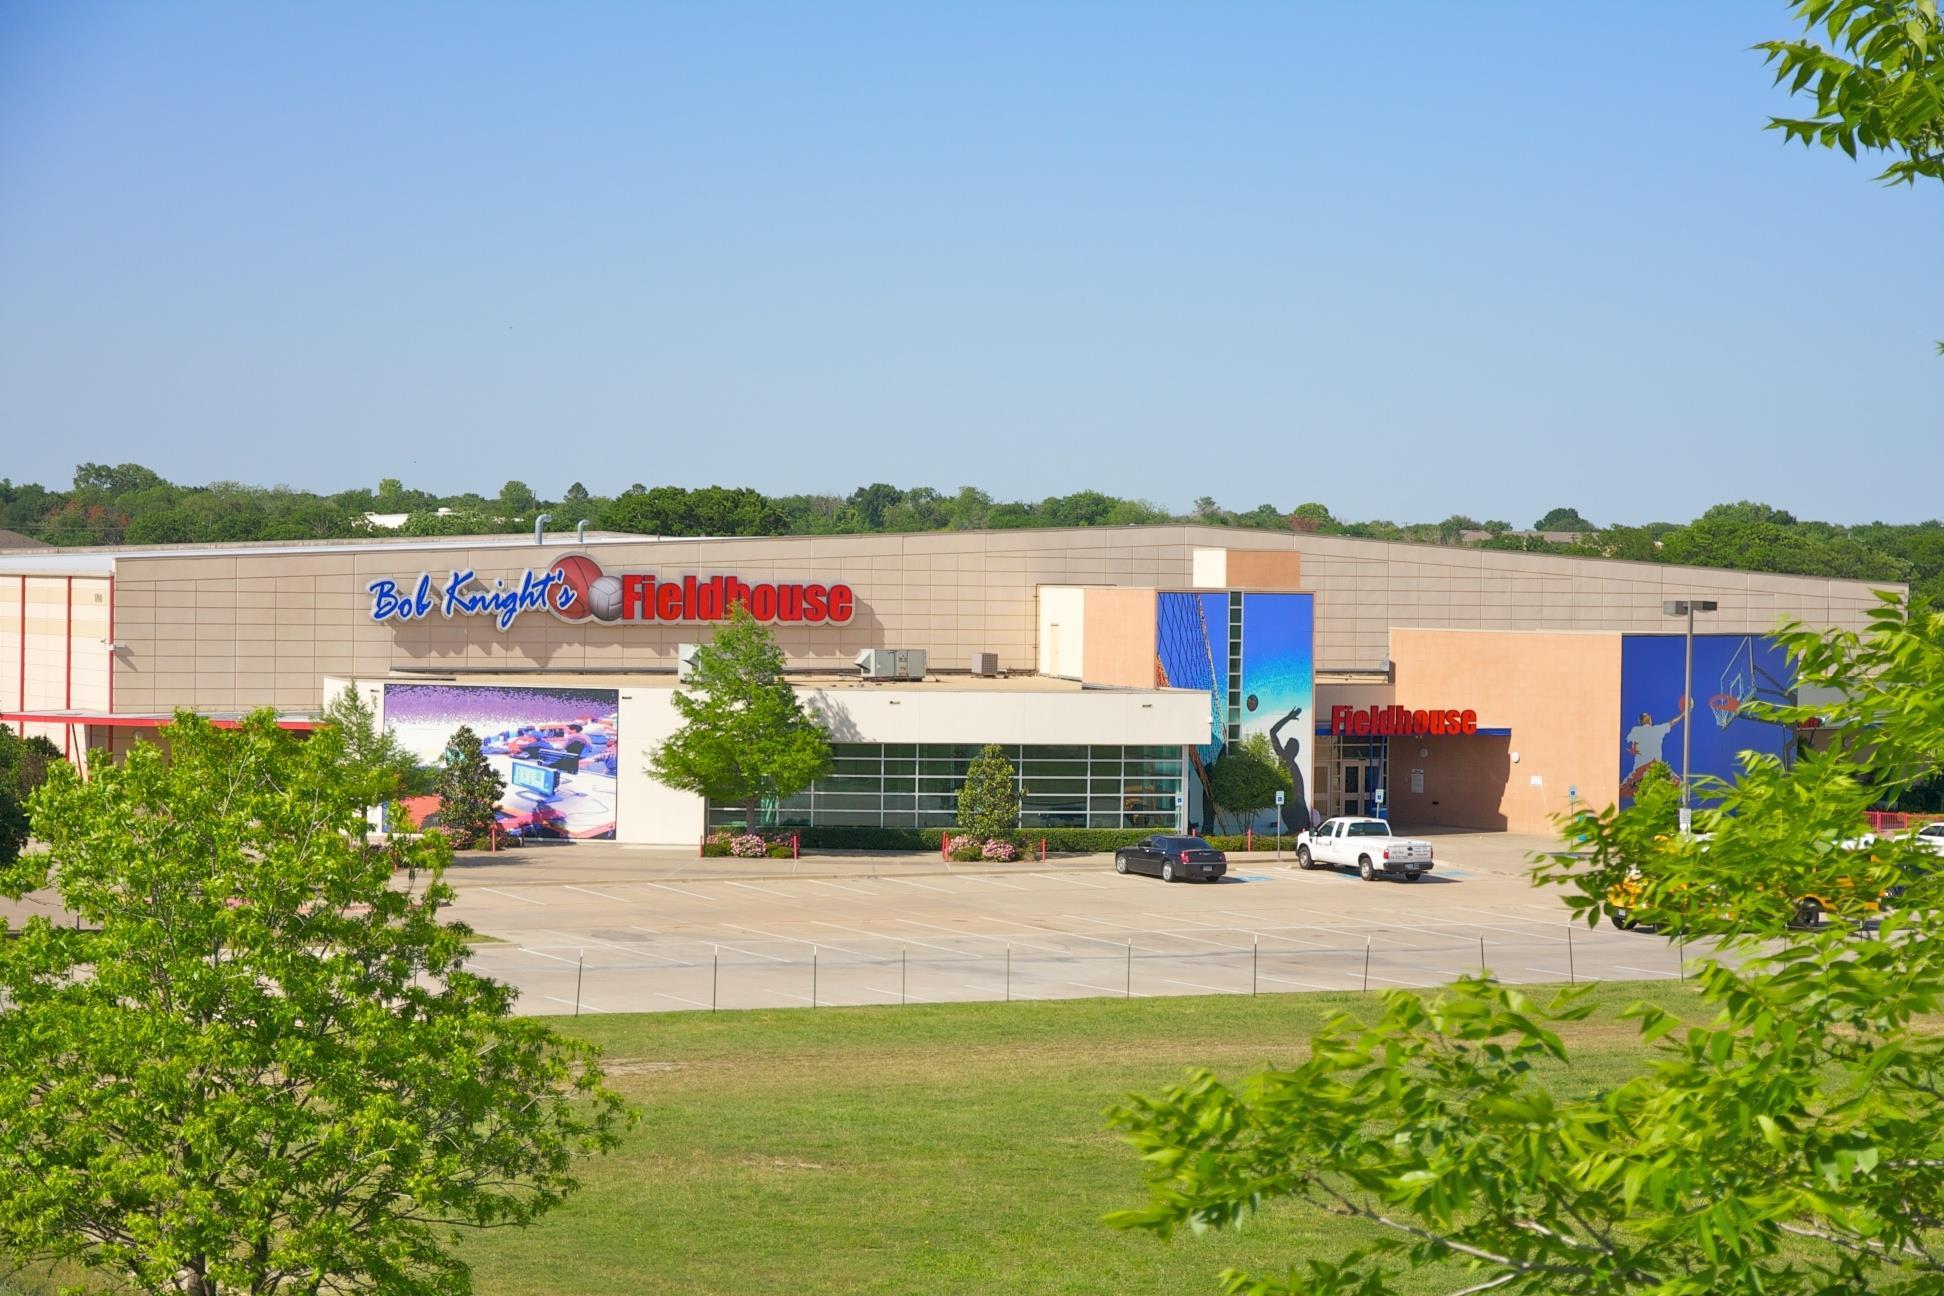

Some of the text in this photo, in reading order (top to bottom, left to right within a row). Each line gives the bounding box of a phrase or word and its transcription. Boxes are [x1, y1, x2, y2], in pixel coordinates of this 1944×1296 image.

[369, 570, 853, 628] Bob Knight's Fieldhouse
[1331, 704, 1477, 736] Fieldhouse
